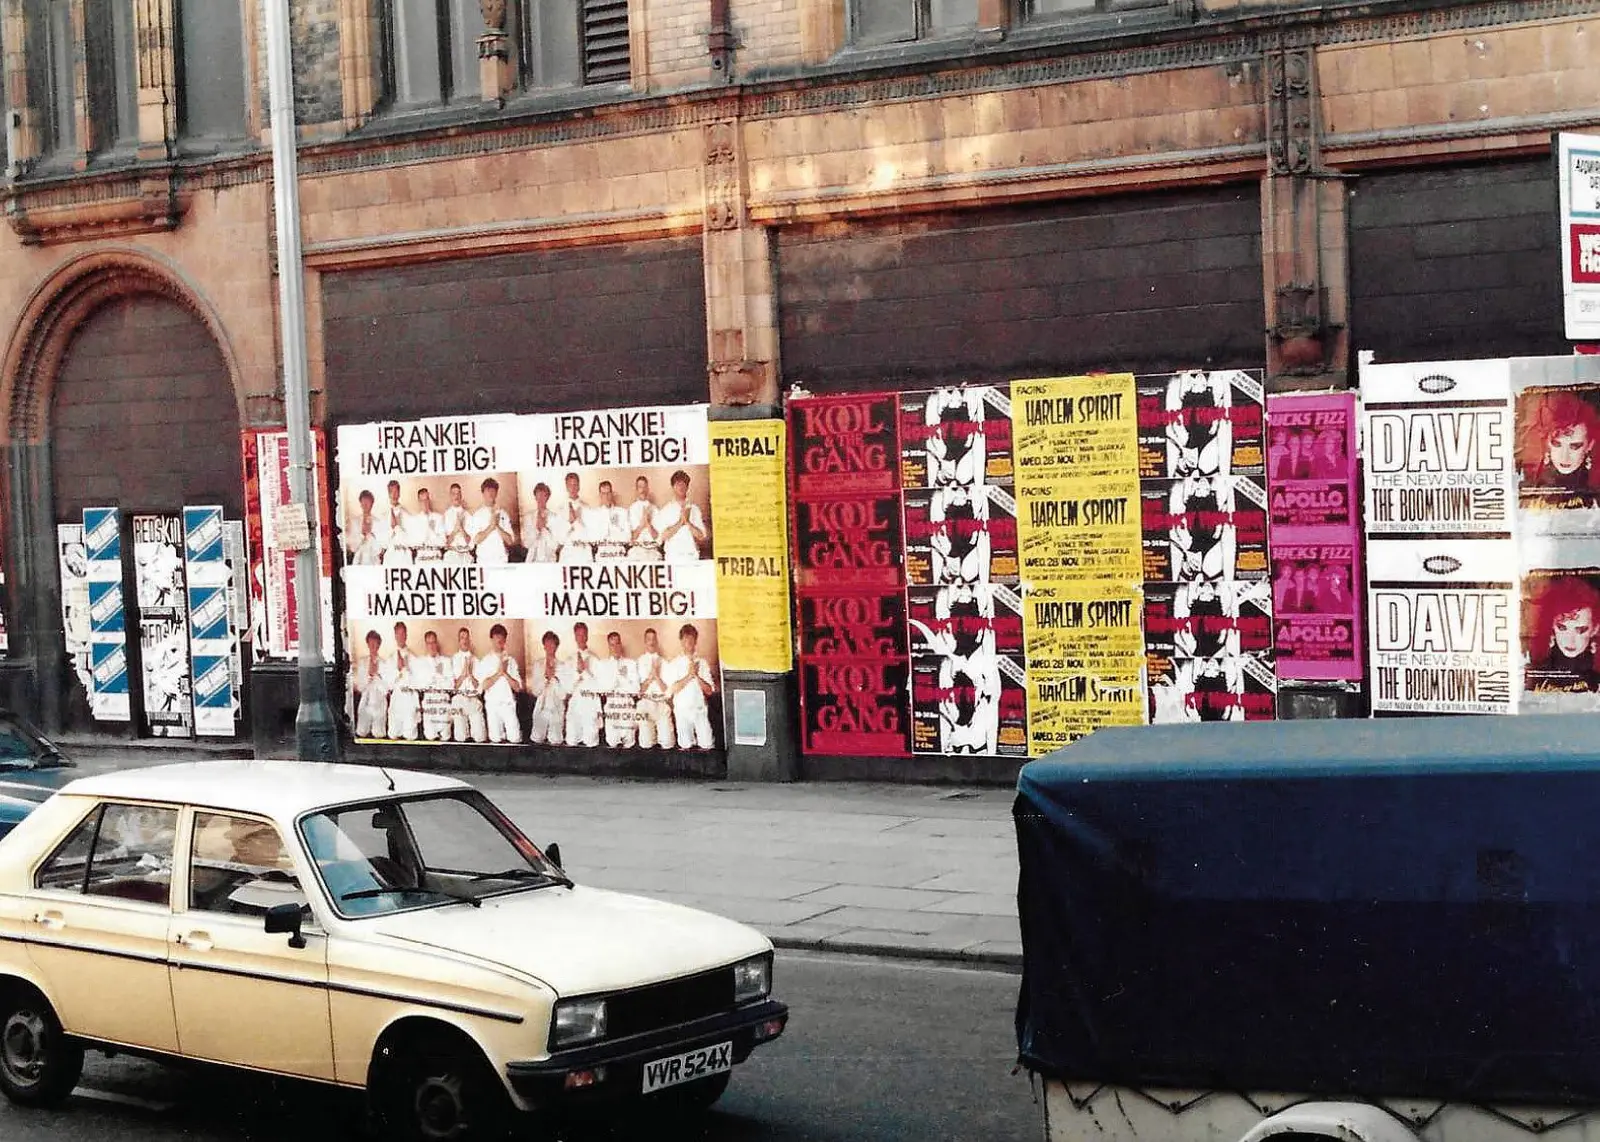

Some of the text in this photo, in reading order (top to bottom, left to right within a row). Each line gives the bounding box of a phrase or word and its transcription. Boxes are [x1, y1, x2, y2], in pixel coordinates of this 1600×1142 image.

[1025, 397, 1074, 426] HARLEM
[1078, 393, 1123, 423] SPIRIT
[1315, 412, 1346, 424] FIZZ
[379, 422, 476, 449] !FRANKIE!
[554, 411, 666, 440] !FRANKIE!
[536, 437, 688, 467] !MADE IT BIG!
[1370, 412, 1504, 473] DAVE
[361, 446, 496, 475] !MADE IT BIG!
[805, 444, 886, 472] GANG
[1372, 473, 1504, 486] THE NEW SINGLE
[1274, 490, 1343, 508] APOLLO
[1372, 487, 1471, 521] THE BOOMTOWN
[1473, 488, 1505, 520] RATS
[1030, 498, 1128, 528] HARLEM SPIRIT
[809, 541, 891, 567] GANG
[1047, 558, 1059, 566] 28
[1320, 547, 1351, 559] FIZZ
[385, 567, 484, 591] !FRANKIE!
[562, 565, 673, 590] !FRANKIE!
[368, 592, 505, 616] !MADE IT BIG!
[544, 590, 695, 617] !MADE IT BIG!
[1035, 600, 1132, 629] HARLEM SPIRIT
[1278, 625, 1349, 641] APOLLO
[1376, 592, 1509, 653] DAVE
[1052, 659, 1064, 669] 28
[1377, 653, 1508, 667] THE NEW SINGLE
[1039, 677, 1086, 702] HARLEM
[1377, 666, 1476, 701] THE BOOMTOWN
[1478, 670, 1510, 703] RATS
[817, 705, 898, 732] GANG
[1055, 732, 1067, 741] 28
[646, 1044, 731, 1087] VVR 524X
